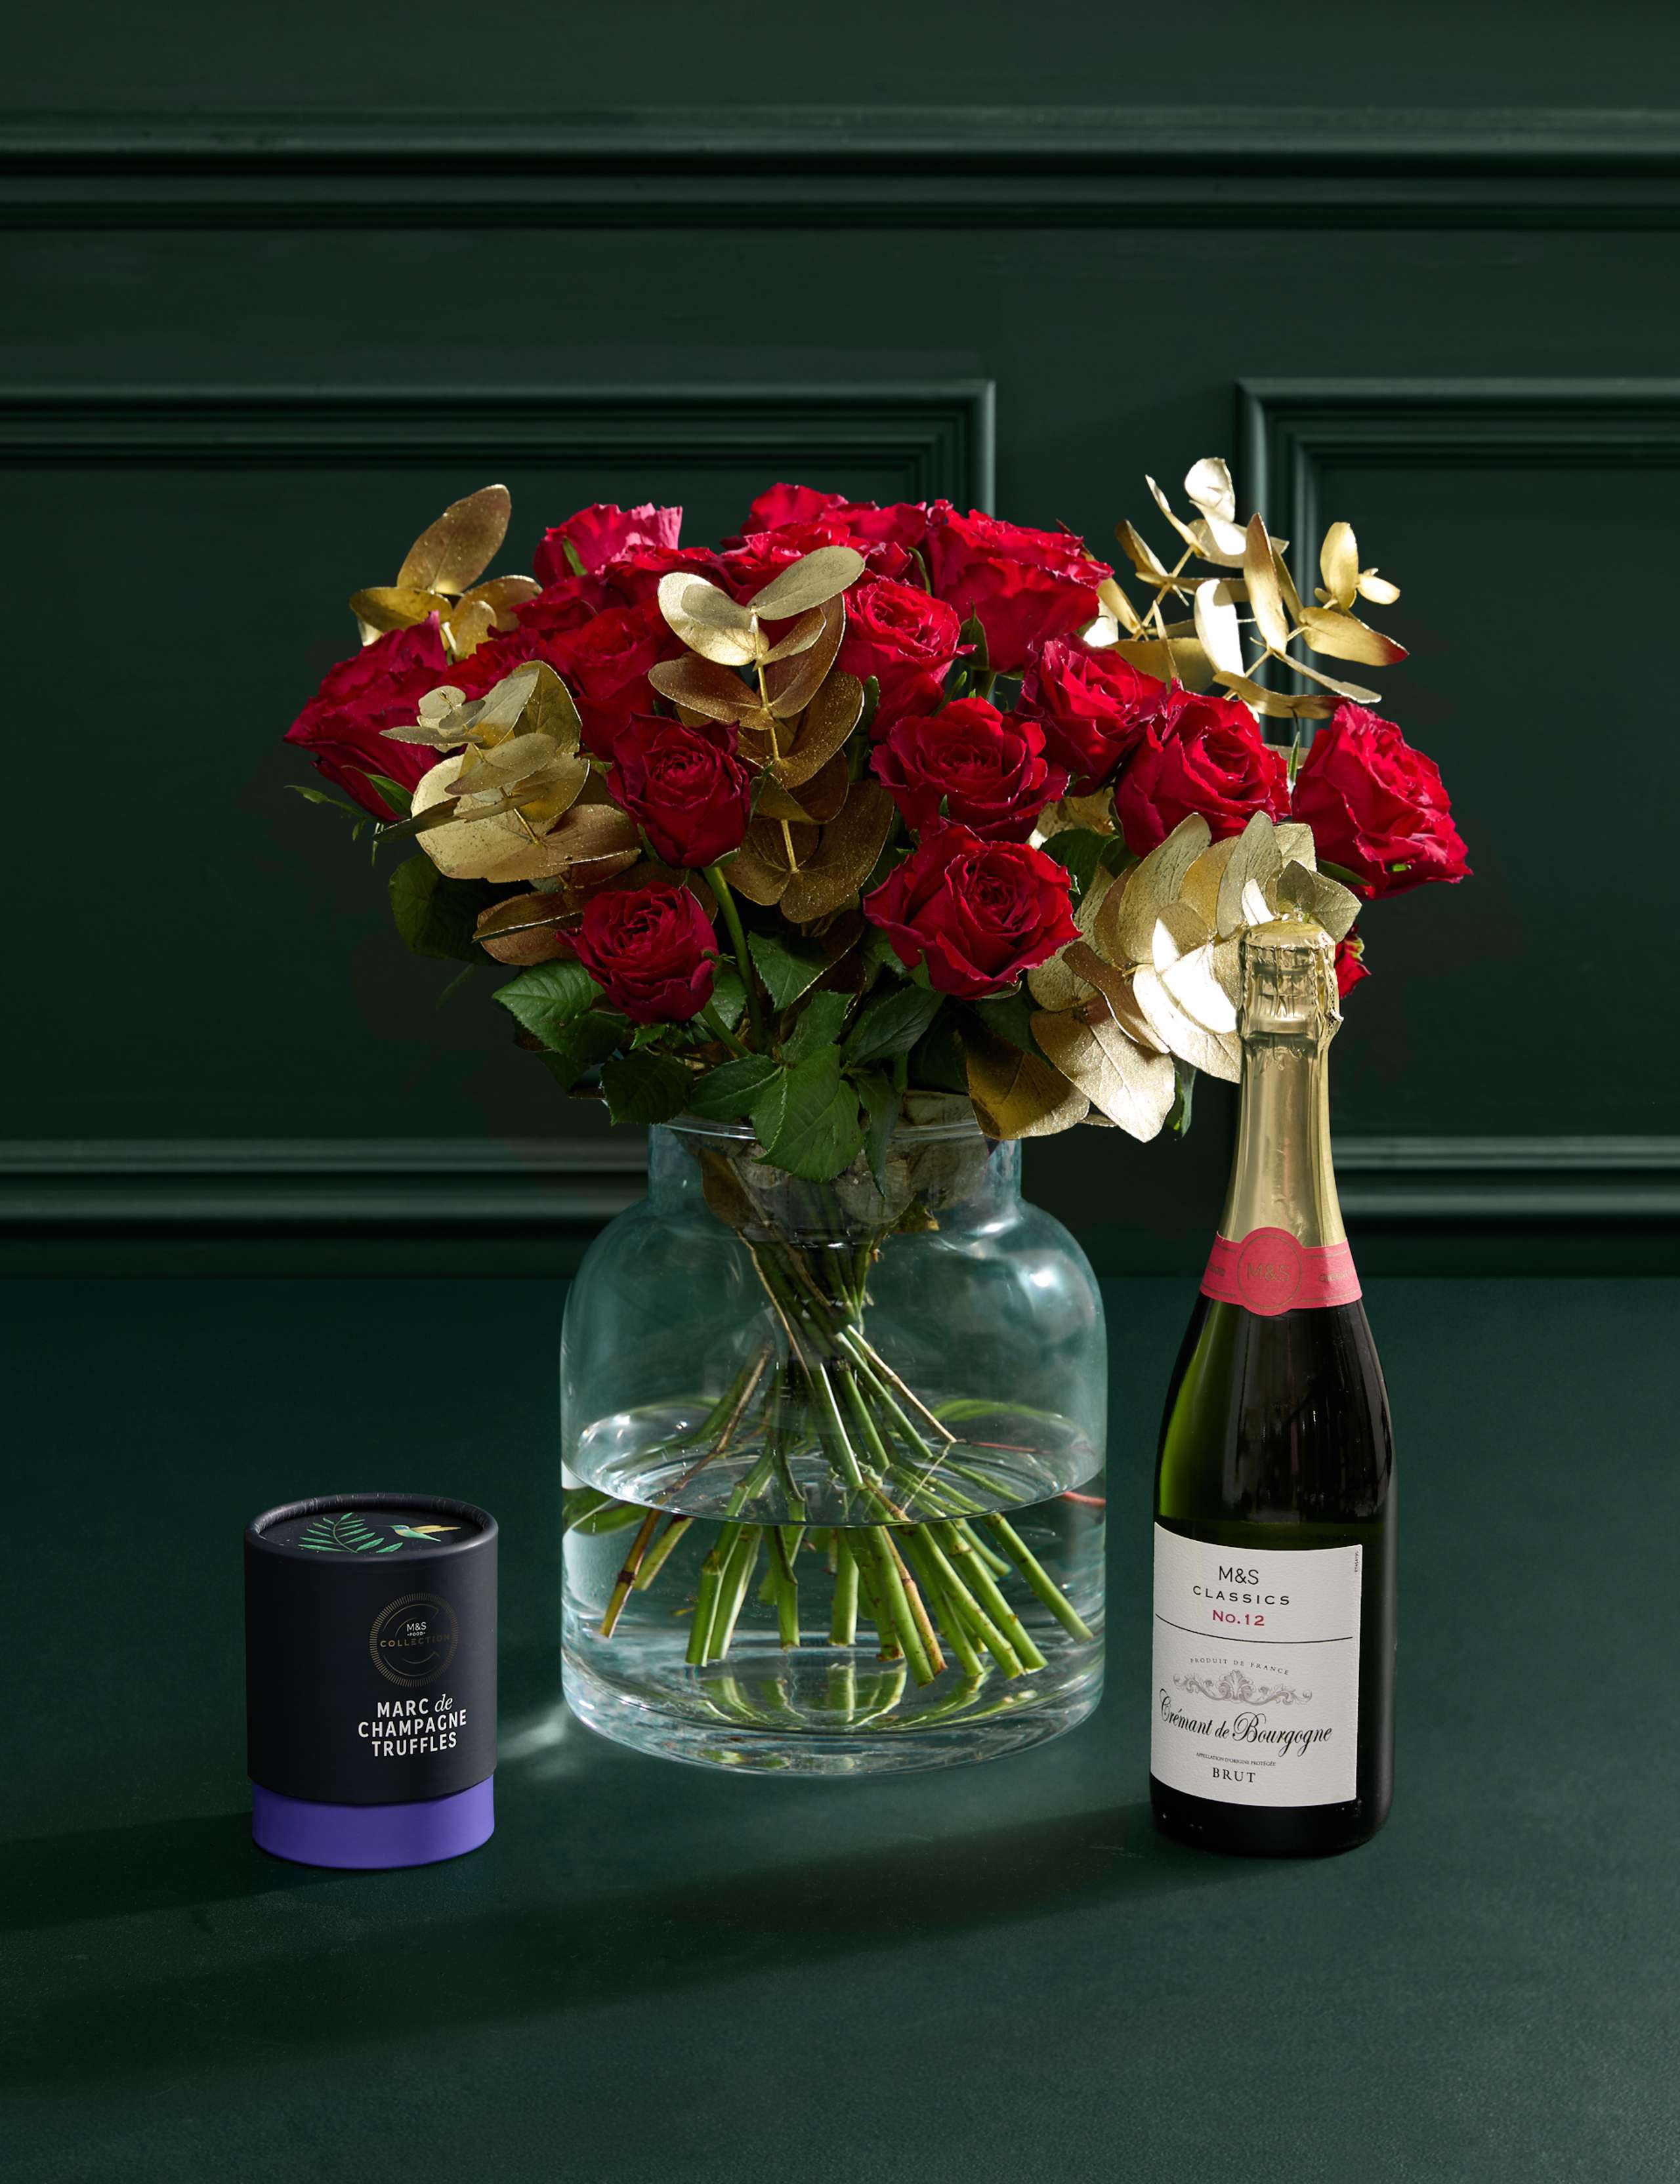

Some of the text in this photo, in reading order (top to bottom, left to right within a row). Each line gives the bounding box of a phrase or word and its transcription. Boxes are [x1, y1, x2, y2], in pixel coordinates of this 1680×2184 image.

[1248, 1264, 1290, 1281] M&S
[1219, 1566, 1259, 1585] M&S
[1192, 1586, 1290, 1605] CLASSICS
[406, 1622, 427, 1631] M&S
[1212, 1610, 1265, 1626] No.12
[380, 1633, 450, 1647] COLLECTION
[1250, 1662, 1289, 1675] FRANCE
[377, 1694, 453, 1717] MARC de
[358, 1709, 467, 1738] CHAMPAGNE
[1159, 1689, 1332, 1757] Crémant de Bourgogne
[371, 1731, 457, 1757] TRUFFLES
[1212, 1767, 1256, 1782] BRUT
